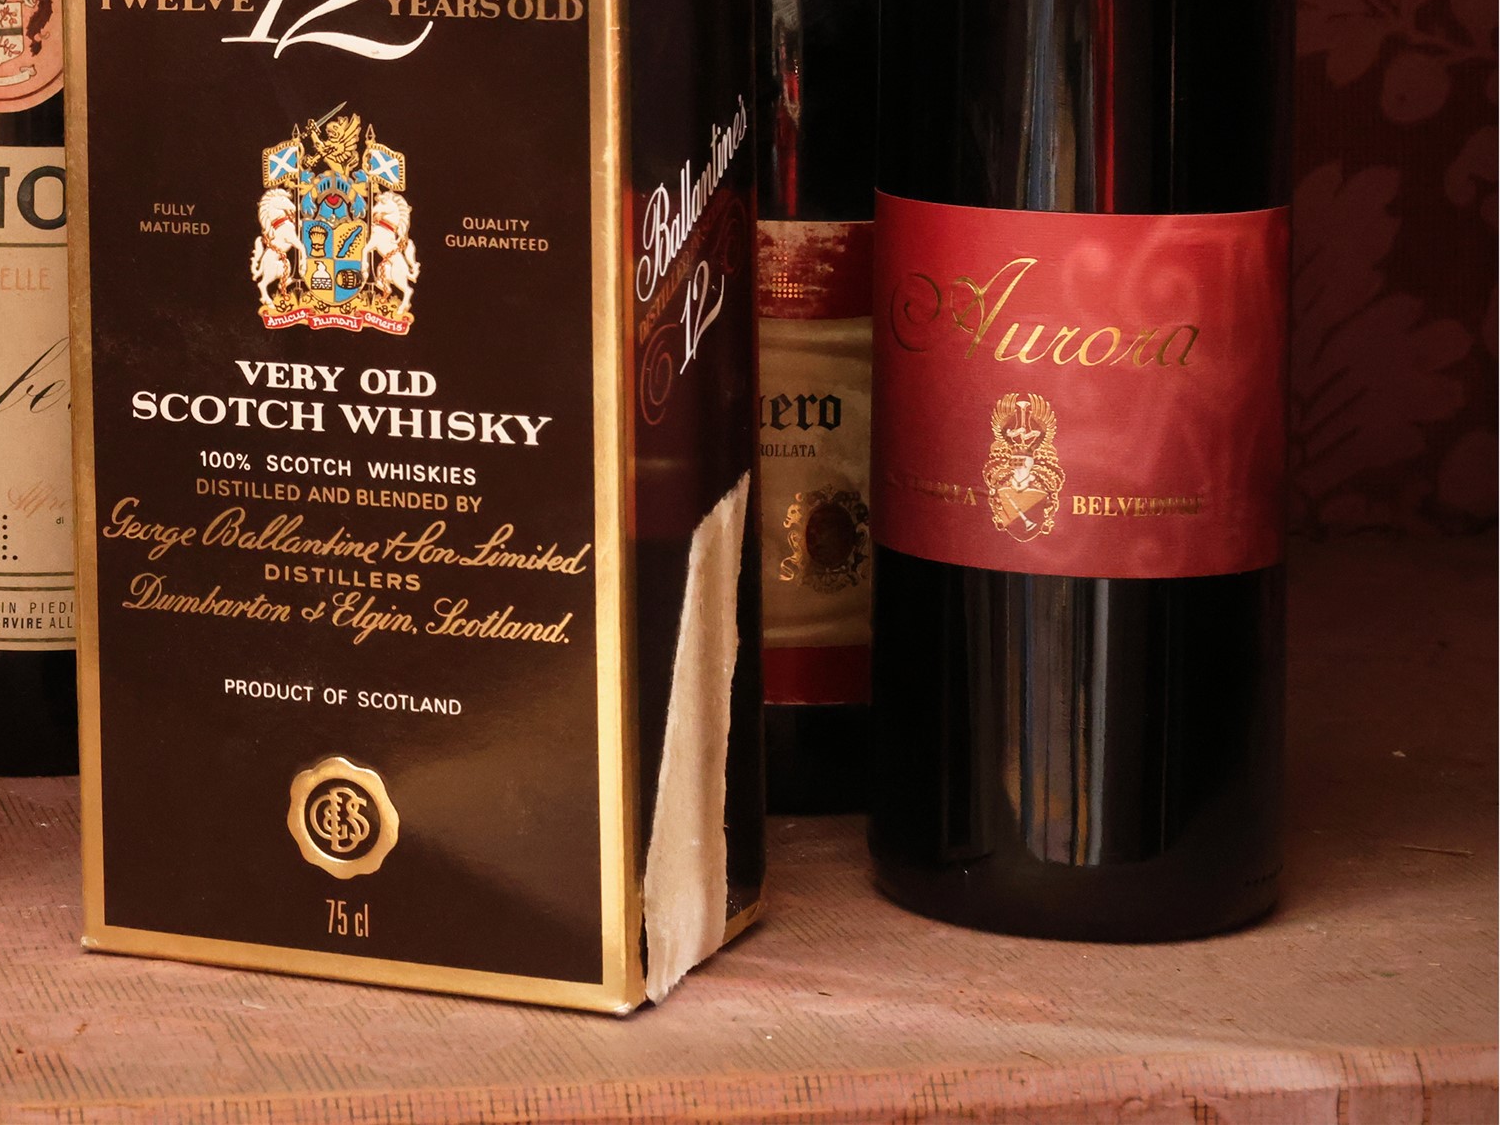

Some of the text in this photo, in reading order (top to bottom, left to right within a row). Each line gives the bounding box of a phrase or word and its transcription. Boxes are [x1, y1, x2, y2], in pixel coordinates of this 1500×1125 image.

[154, 202, 196, 217] FULLY
[636, 94, 748, 303] Ballantine's
[139, 220, 211, 236] MATURED
[445, 234, 550, 253] GUARANTEED
[462, 217, 530, 233] QUALITY
[679, 260, 725, 375] 12
[890, 257, 1201, 367] Aurora
[234, 360, 437, 397] VERY OLD
[132, 391, 553, 446] SCOTCH WHISKY
[200, 450, 477, 486] 100% SCOTCH WHISKIES
[196, 478, 483, 513] DISTILLED AND BLENDED BY
[102, 496, 197, 560] George
[201, 506, 379, 565] Ballantine
[397, 520, 460, 566] Son
[459, 523, 592, 575] Limited
[264, 562, 421, 592] DISTILLERS
[1, 601, 17, 614] IN
[122, 573, 291, 624] Dumbarton
[330, 591, 419, 645] Elgin,
[425, 597, 570, 645] Scotland.
[224, 678, 462, 717] PRODUCT OF SCOTLAND
[326, 899, 369, 937] 75 cl
